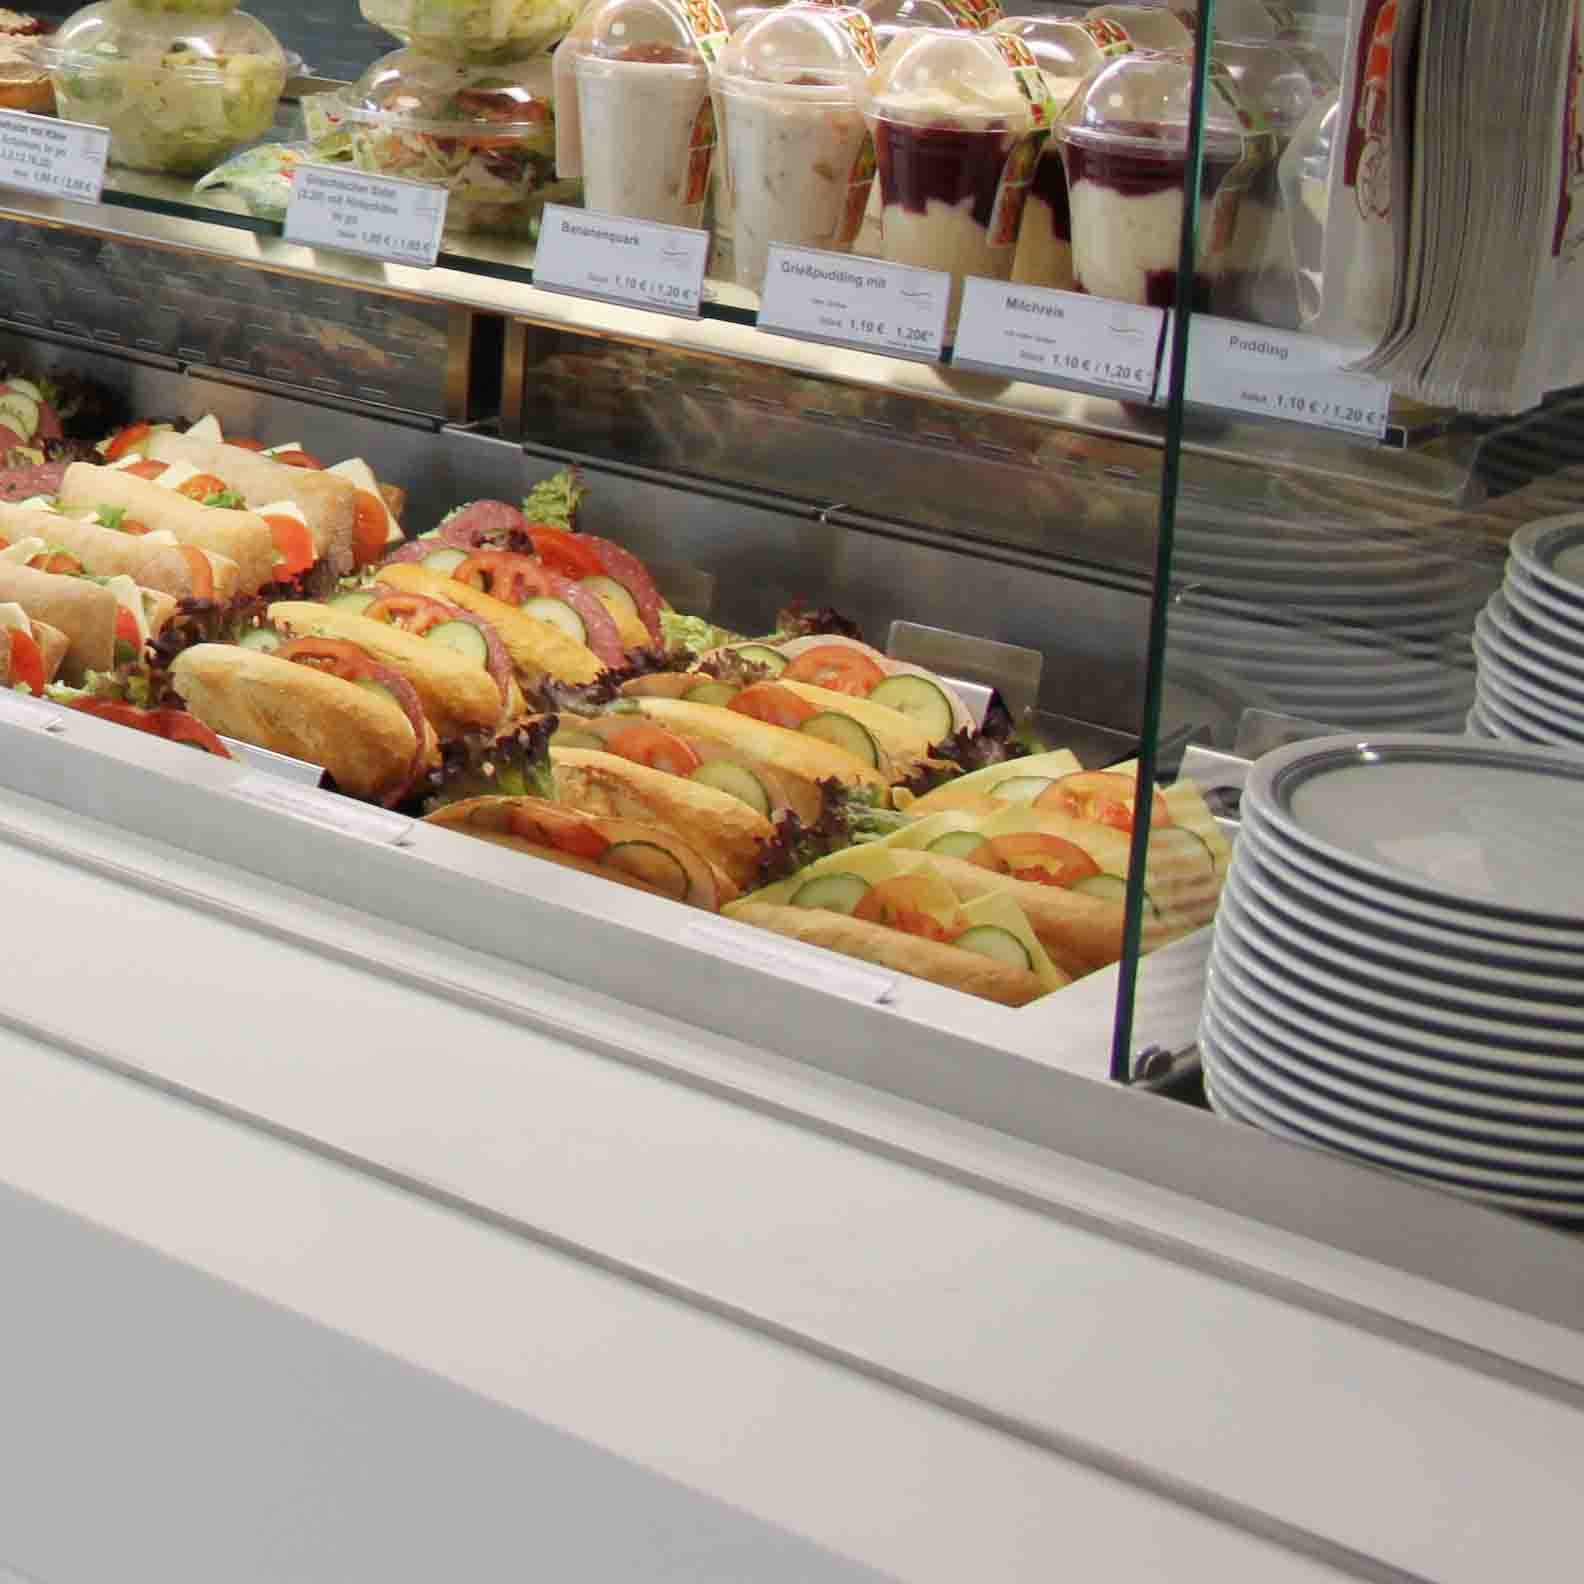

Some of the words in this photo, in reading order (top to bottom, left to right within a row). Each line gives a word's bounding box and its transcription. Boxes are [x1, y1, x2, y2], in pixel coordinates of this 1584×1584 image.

[560, 220, 641, 247] Bananenquark
[781, 260, 863, 288] Grießpudding
[1005, 295, 1066, 319] Milchreis
[1229, 335, 1289, 362] Pudding
[1051, 353, 1080, 370] 1,10
[1104, 362, 1132, 380] 1,20
[1276, 394, 1305, 412] 1,10
[1334, 405, 1363, 422] 1,20
